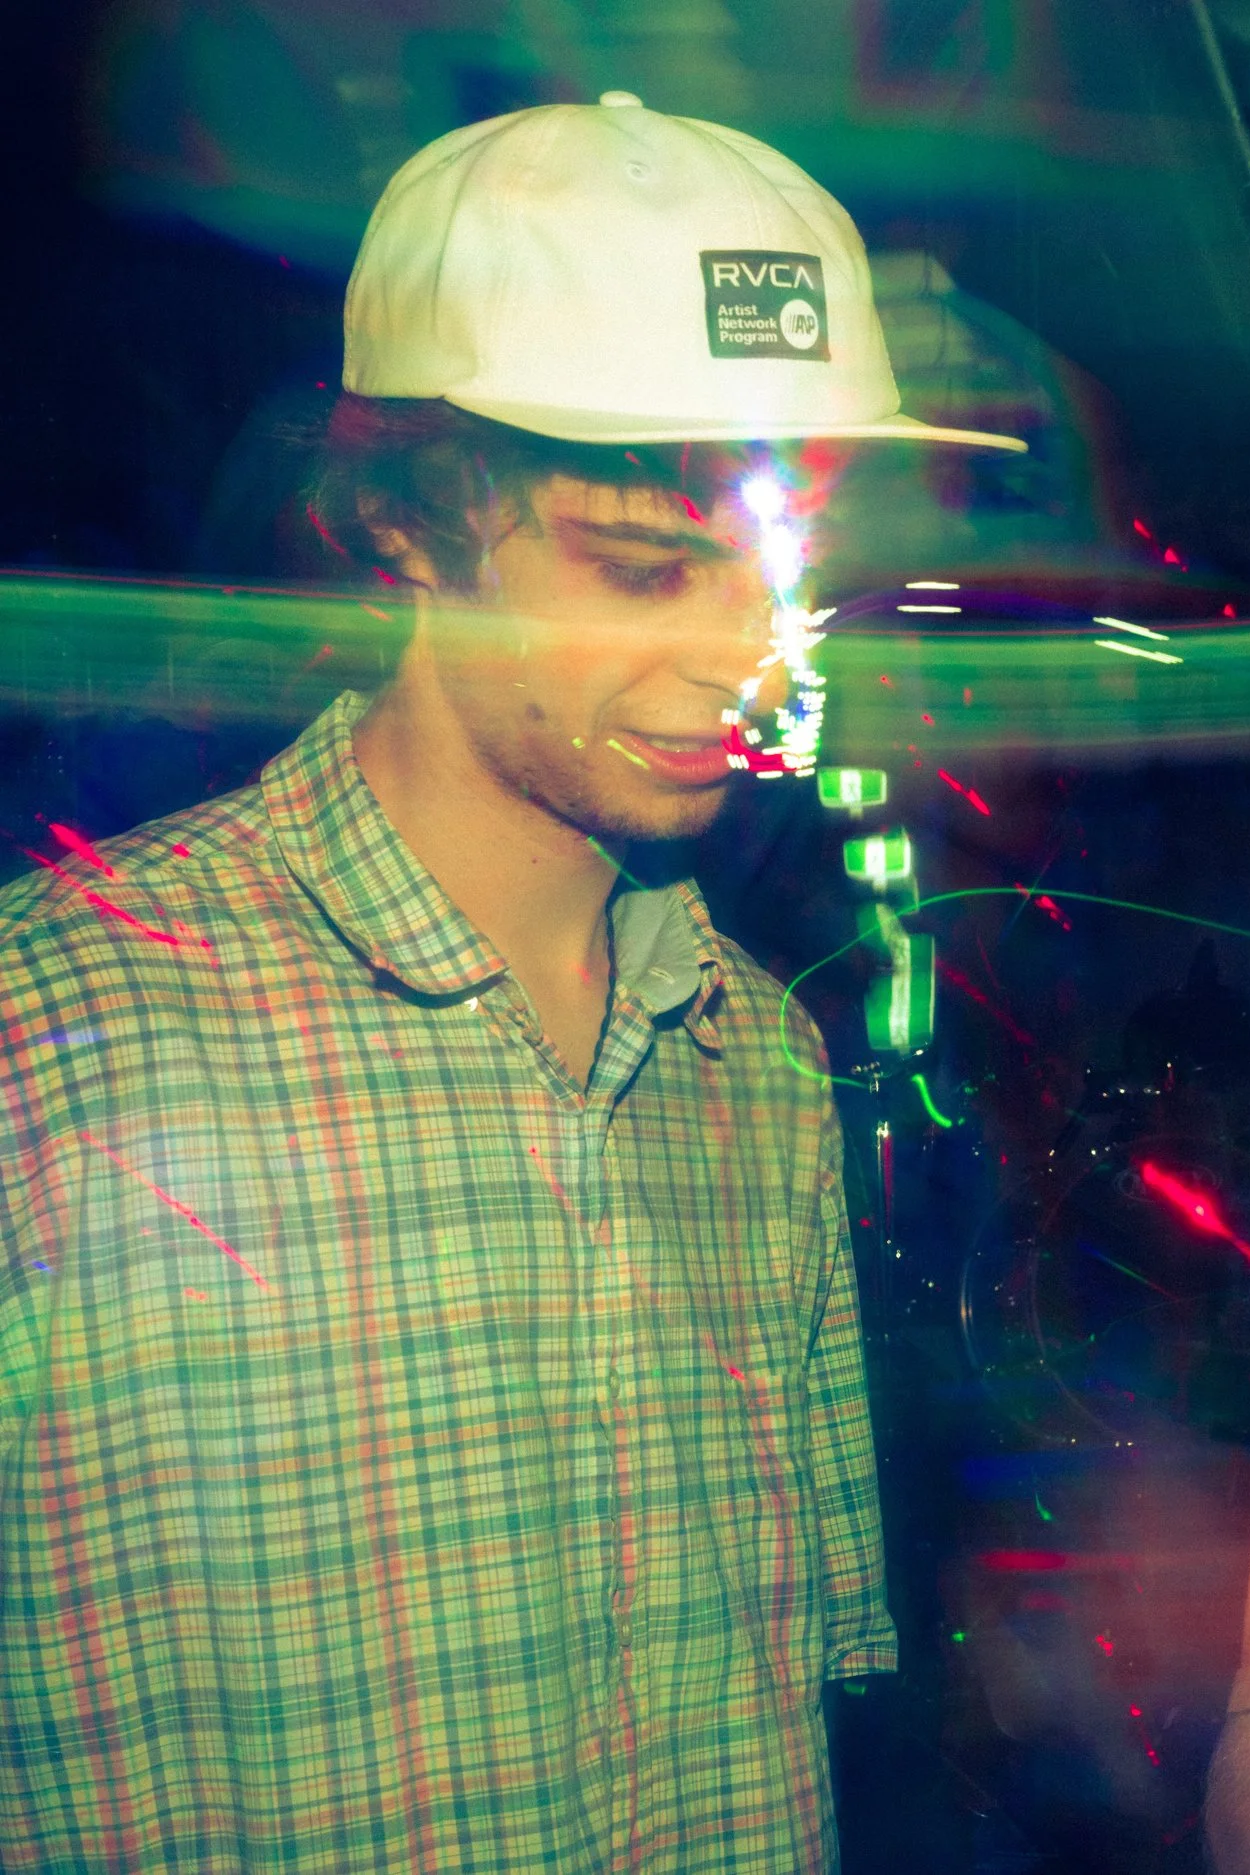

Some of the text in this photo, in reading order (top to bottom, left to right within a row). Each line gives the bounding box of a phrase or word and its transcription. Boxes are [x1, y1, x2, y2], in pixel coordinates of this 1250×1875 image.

[712, 262, 814, 290] RVCA
[718, 304, 758, 317] Artist
[718, 317, 778, 331] Network
[719, 330, 778, 346] Program
